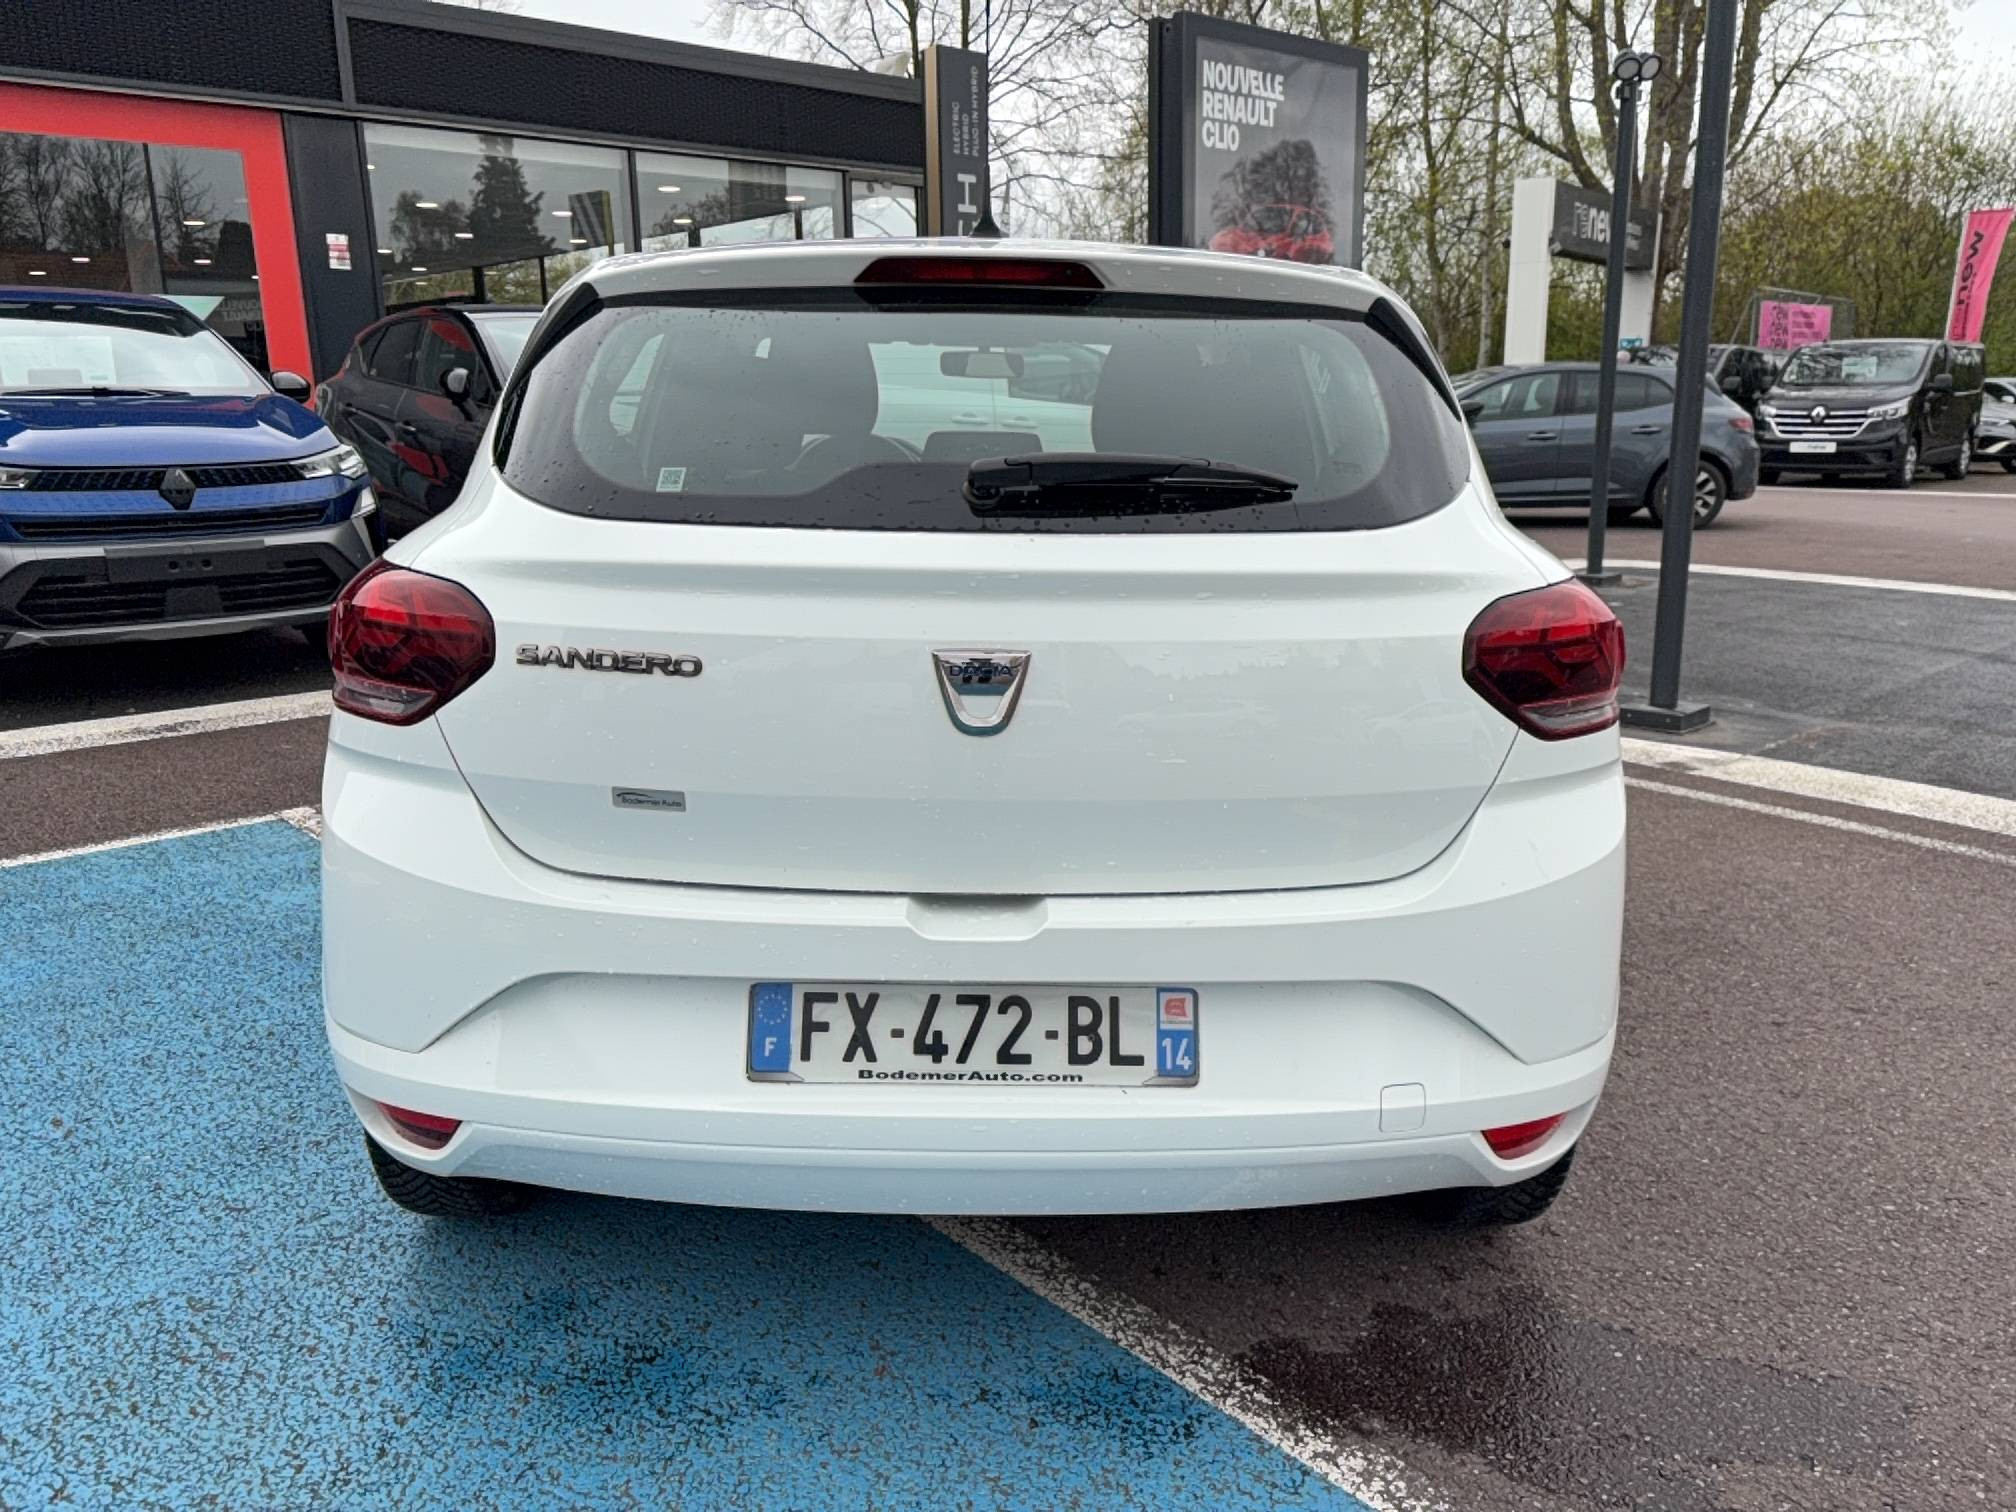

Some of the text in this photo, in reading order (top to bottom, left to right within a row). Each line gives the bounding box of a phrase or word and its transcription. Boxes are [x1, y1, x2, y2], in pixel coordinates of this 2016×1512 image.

[970, 65, 979, 109] HYBRID
[1203, 60, 1285, 101] NOUVELLE
[1203, 90, 1278, 128] RENAULT
[952, 101, 960, 155] ELECTRIC
[962, 113, 970, 155] HYBRID
[1202, 120, 1240, 152] CLIO
[516, 644, 703, 677] SANDERO
[949, 664, 1013, 678] DACIA
[800, 992, 1145, 1066] FX-472-BL
[764, 1037, 777, 1057] F
[1162, 1038, 1193, 1070] 14
[858, 1069, 1083, 1083] BodemerAuto.com
